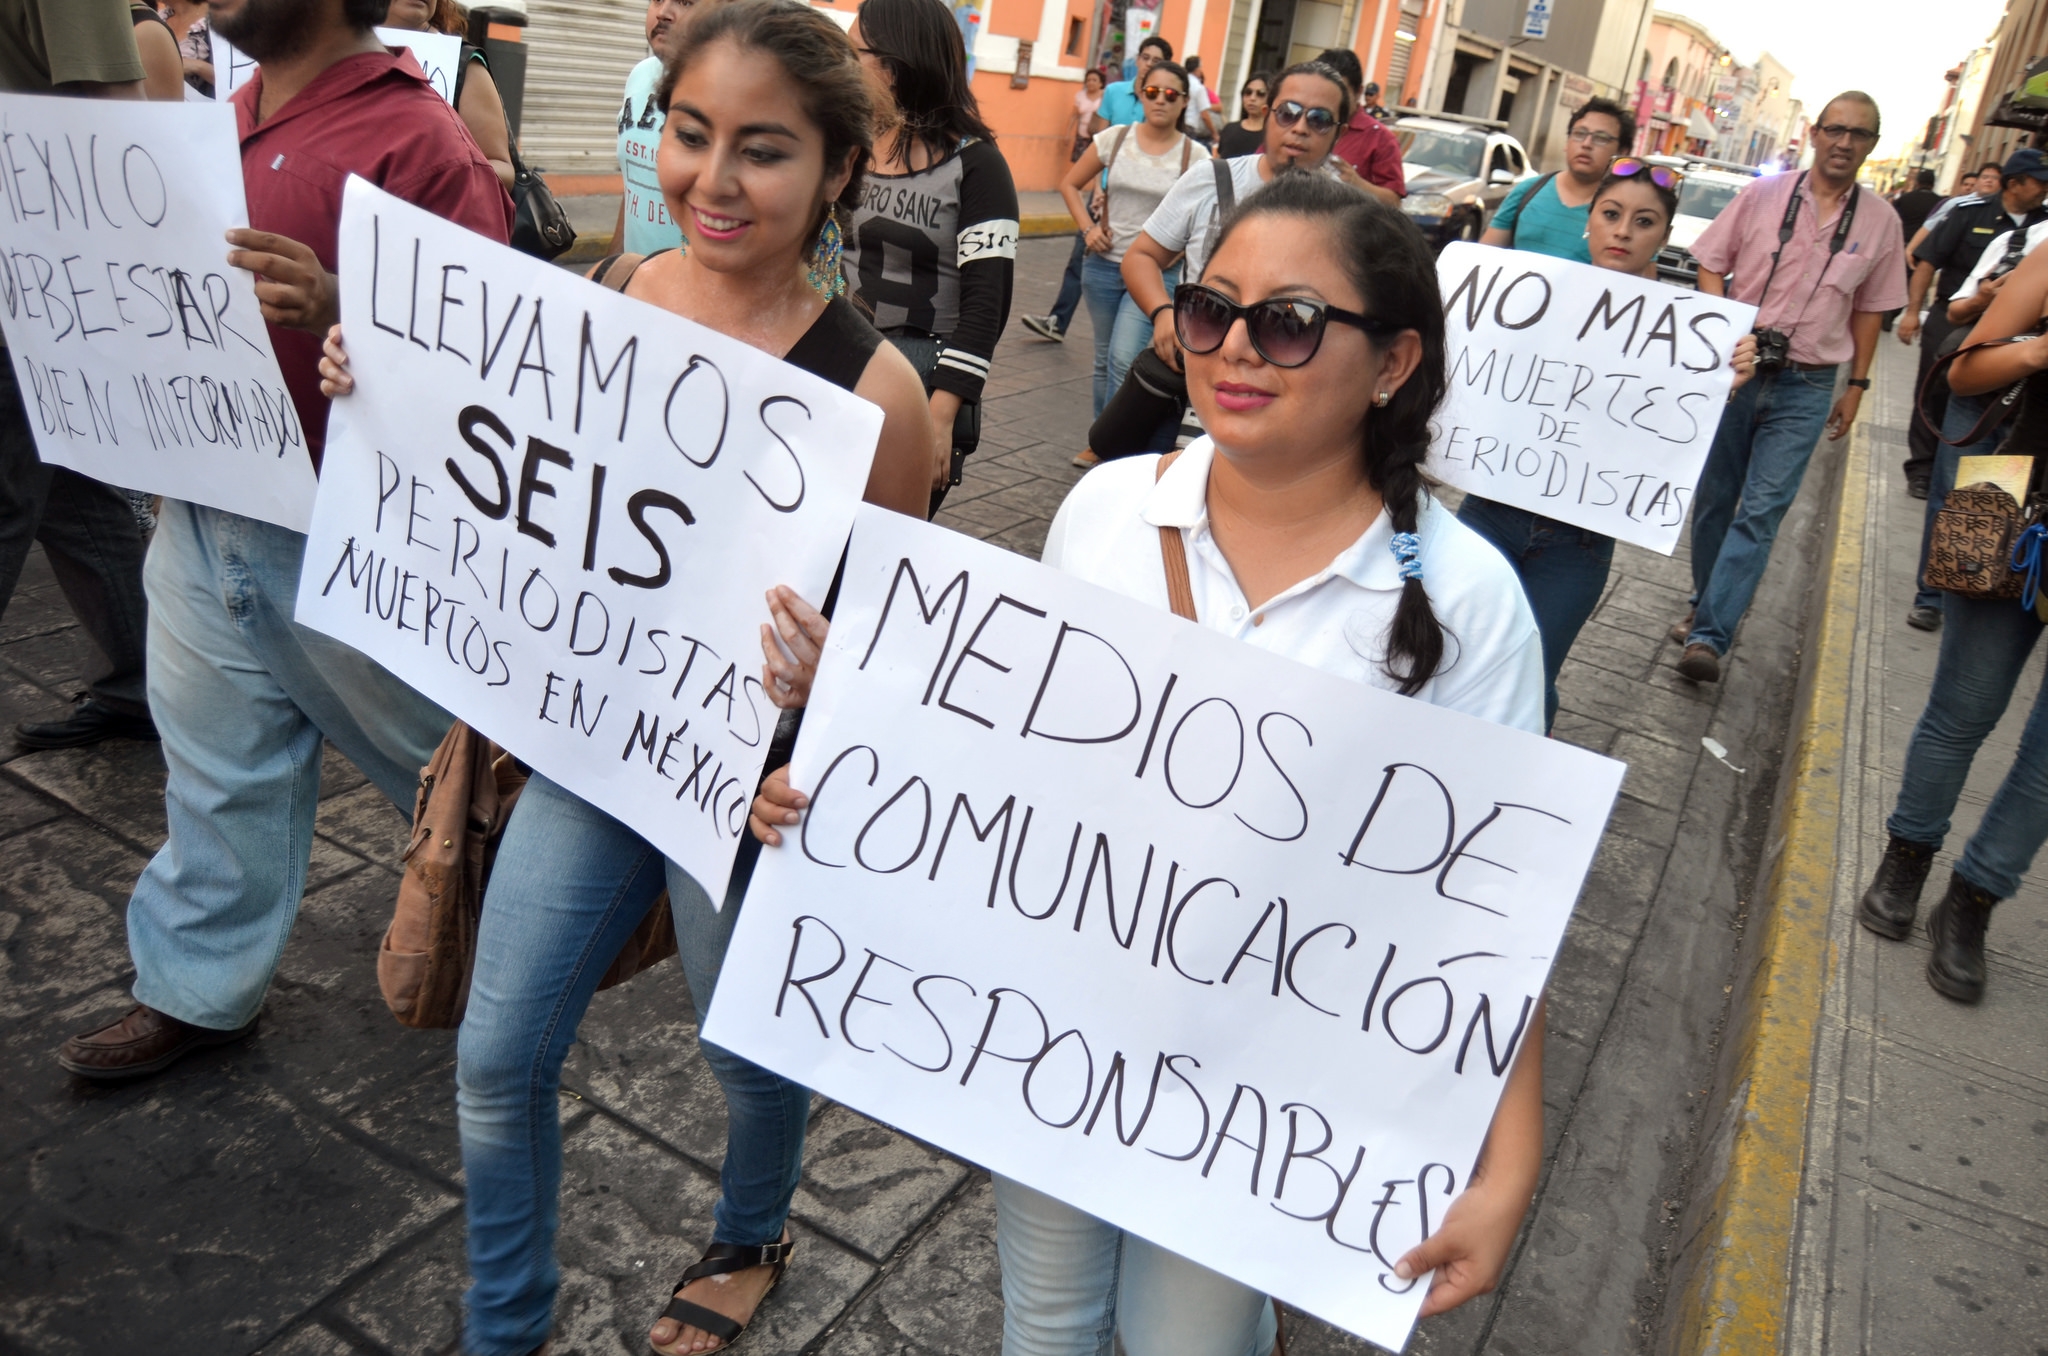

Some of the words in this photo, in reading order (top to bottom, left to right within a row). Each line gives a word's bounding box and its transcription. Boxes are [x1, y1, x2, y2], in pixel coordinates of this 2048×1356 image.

[626, 139, 647, 160] EST.
[893, 188, 942, 229] SANZ
[24, 356, 118, 446] BIEN
[373, 213, 811, 512] LLEVAMOS
[1446, 265, 1551, 332] NO
[1577, 288, 1731, 374] MÁS
[1450, 345, 1710, 443] MUERTES
[446, 405, 696, 589] SEIS
[1538, 412, 1581, 447] DE
[322, 536, 512, 686] MUERTOS
[539, 671, 608, 737] EN
[622, 711, 748, 839] MÉXICO
[376, 451, 766, 747] PERIODISTAS
[858, 556, 1313, 842] MEDIOS
[1338, 763, 1572, 918] DE
[798, 744, 1537, 1079] COMUNICACIÓN
[775, 916, 1456, 1294] RESPONSABLES
